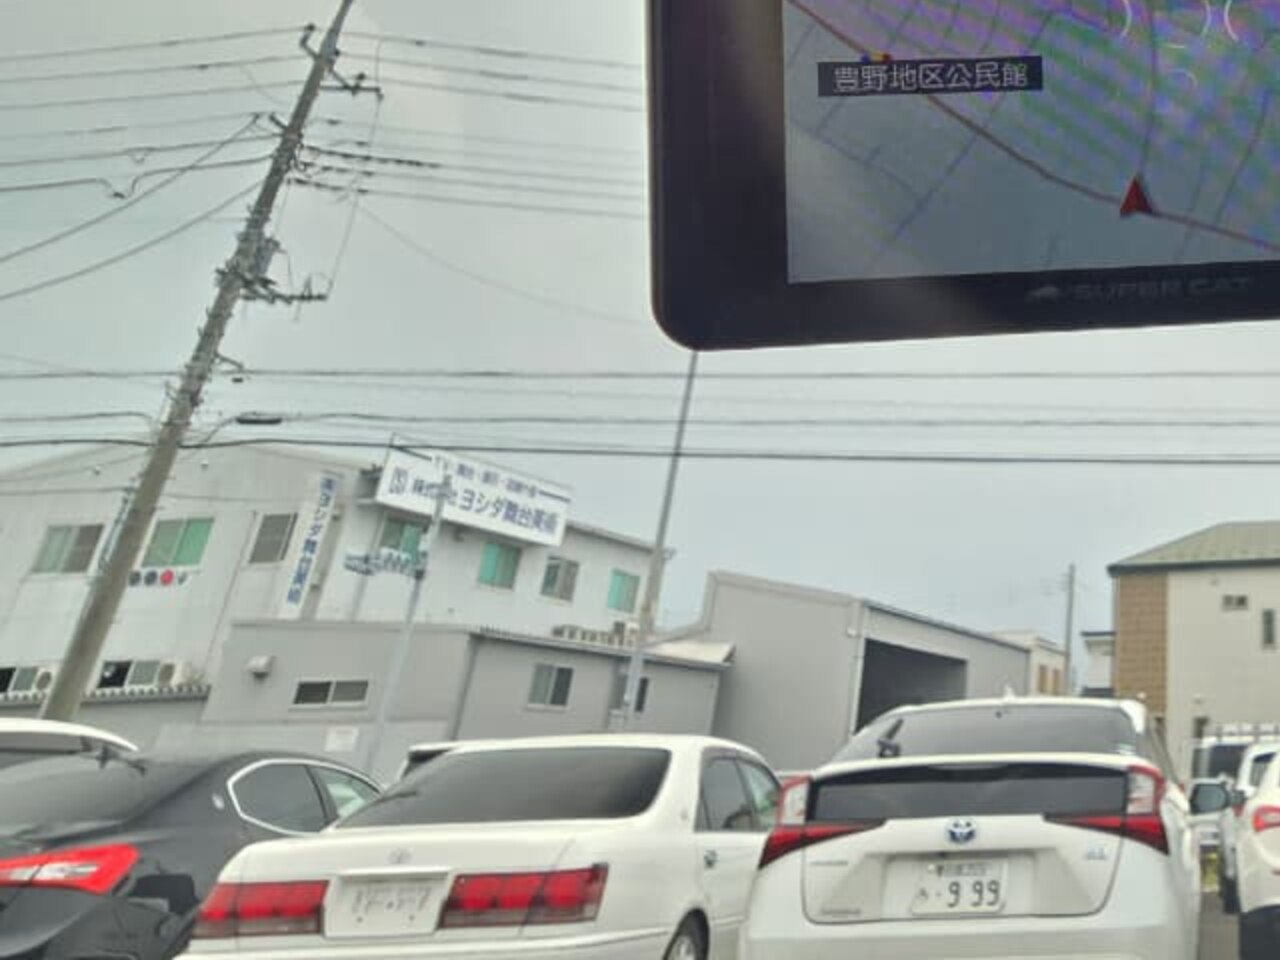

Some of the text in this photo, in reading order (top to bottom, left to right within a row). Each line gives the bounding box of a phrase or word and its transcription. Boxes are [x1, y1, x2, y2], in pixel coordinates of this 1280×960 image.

[833, 62, 1029, 93] 豊野地区公民館
